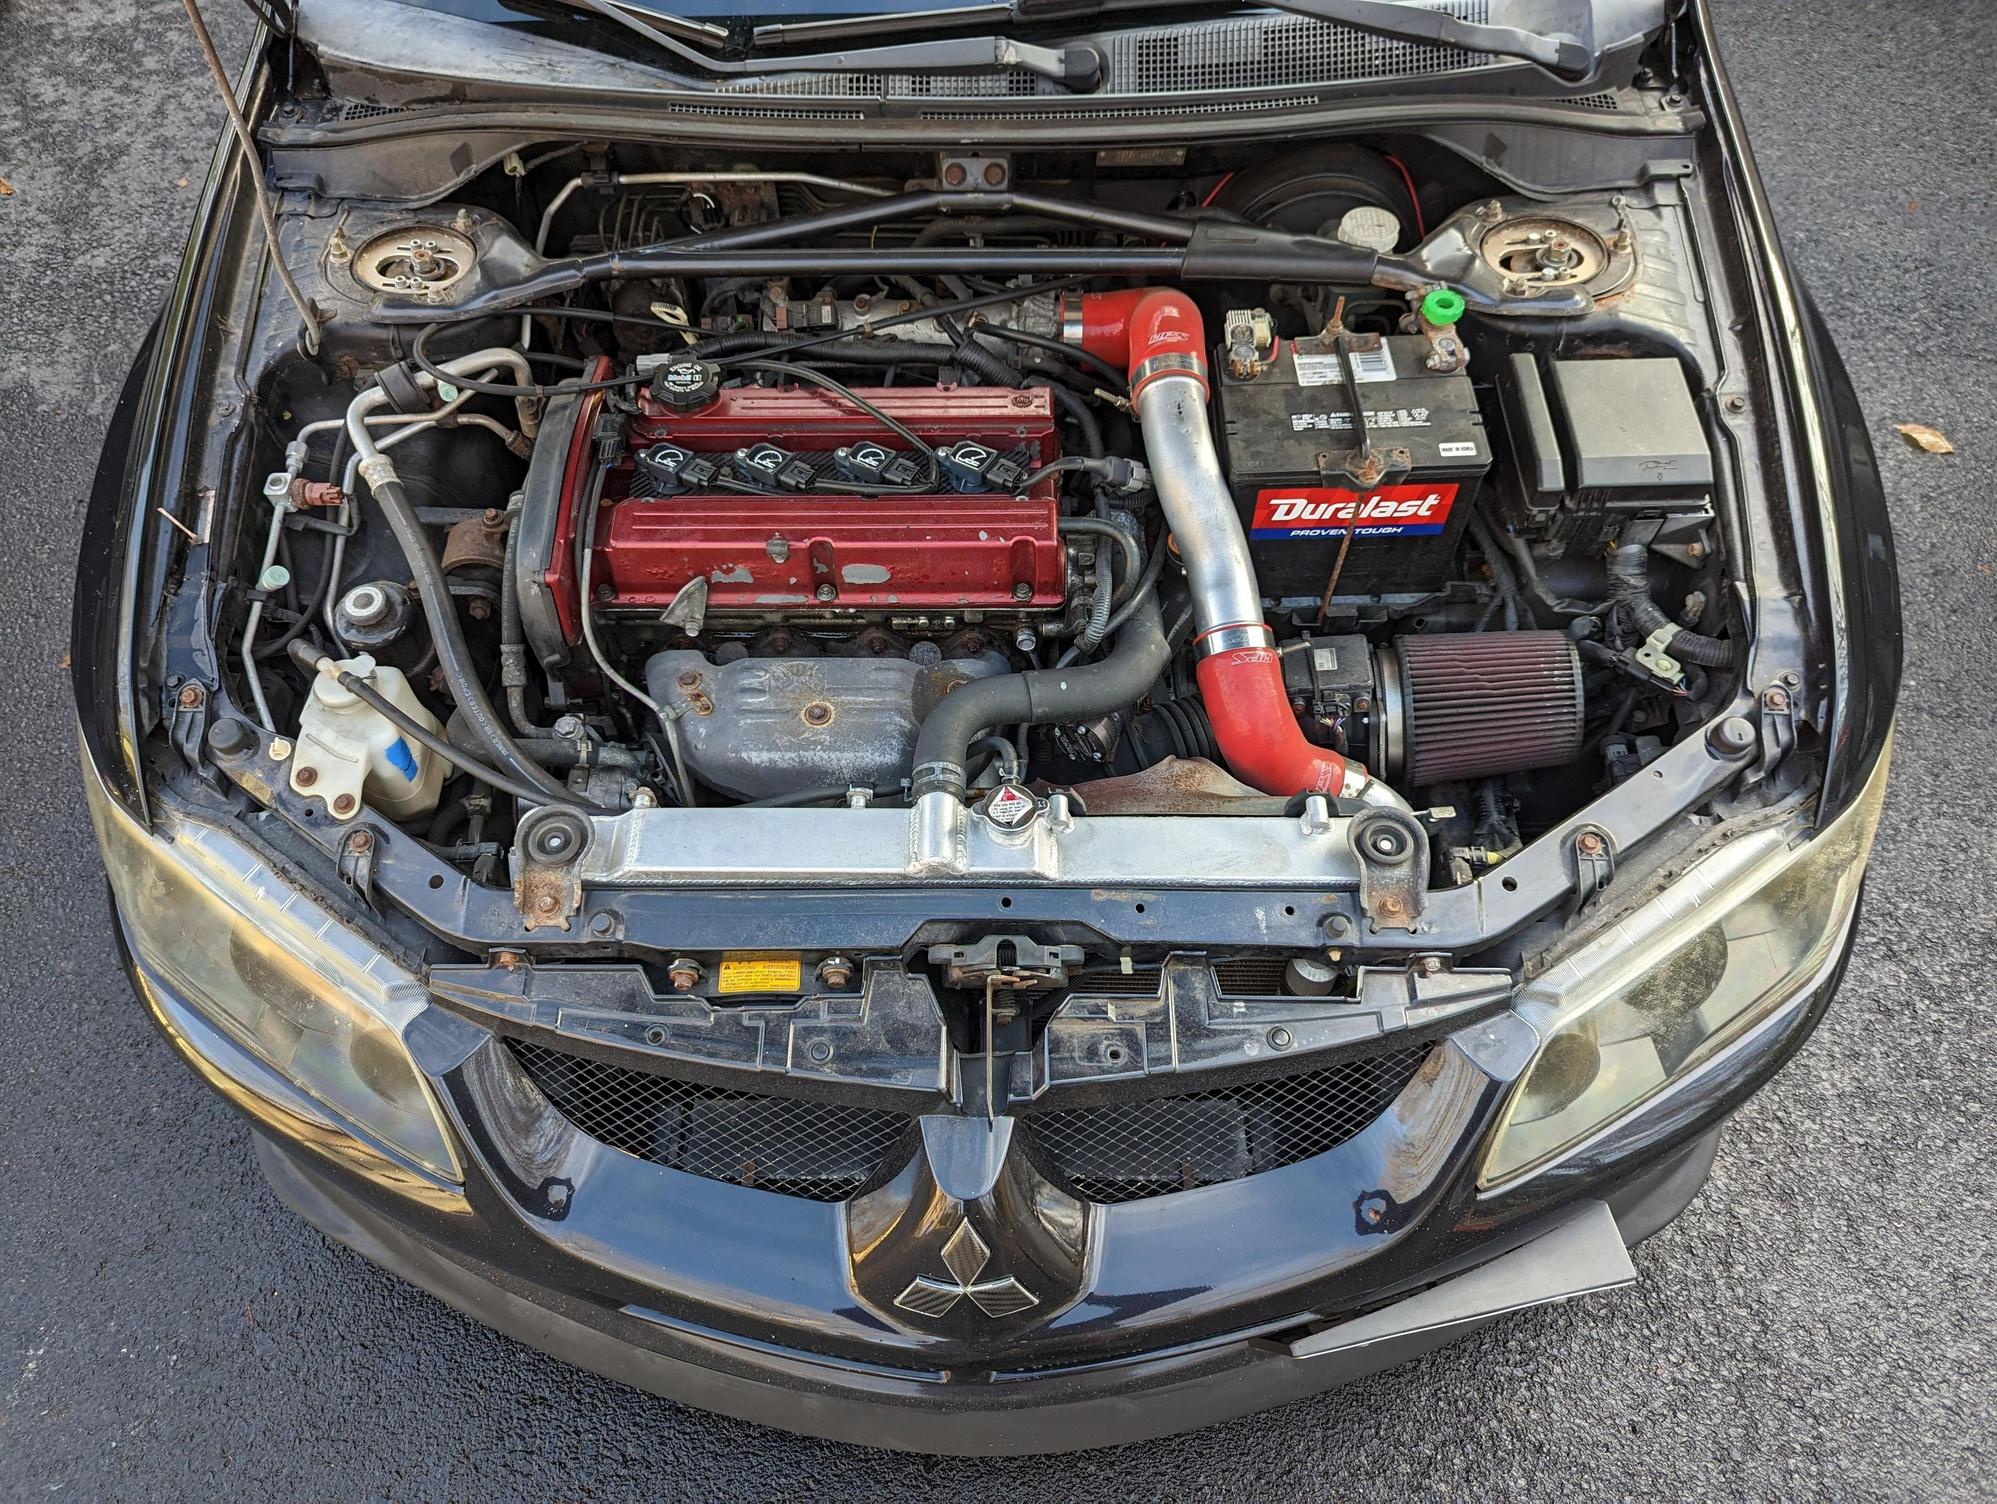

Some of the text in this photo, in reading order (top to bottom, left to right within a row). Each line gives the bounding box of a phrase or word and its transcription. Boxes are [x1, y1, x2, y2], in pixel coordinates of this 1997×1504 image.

[1269, 493, 1441, 521] Duralast
[1290, 526, 1404, 537] PROVEN TOUGH
